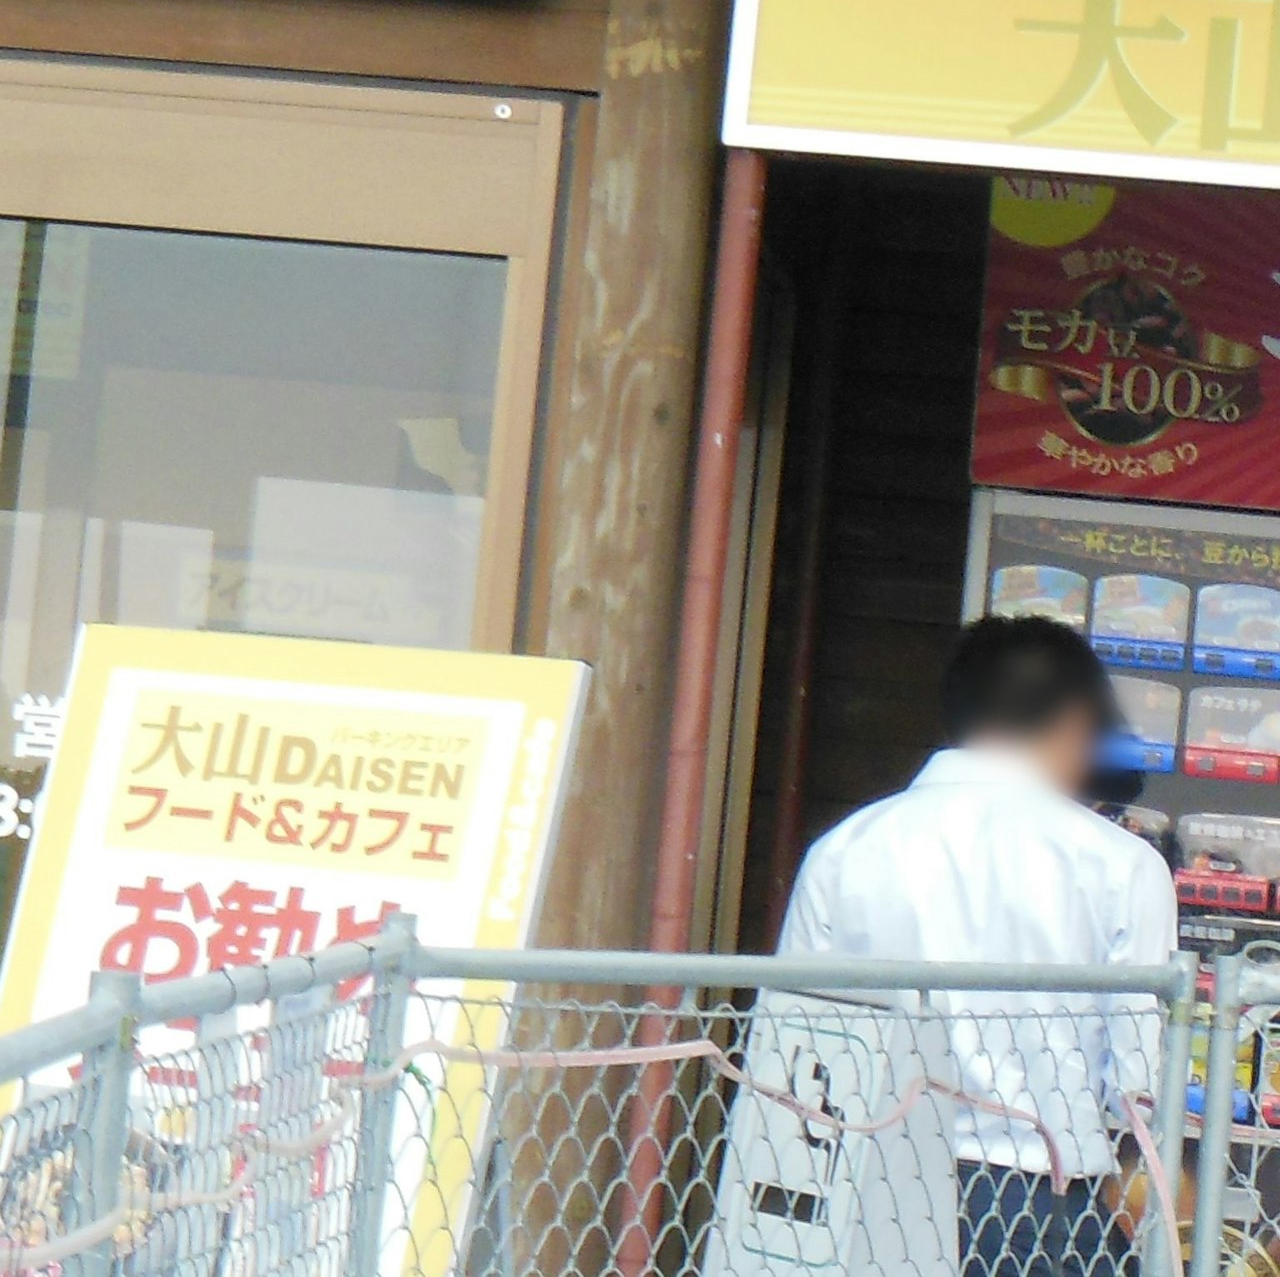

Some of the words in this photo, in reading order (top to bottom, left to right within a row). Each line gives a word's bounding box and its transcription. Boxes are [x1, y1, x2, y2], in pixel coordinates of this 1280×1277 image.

[1088, 361, 1241, 424] 100%
[124, 785, 455, 863] フード&カフェ
